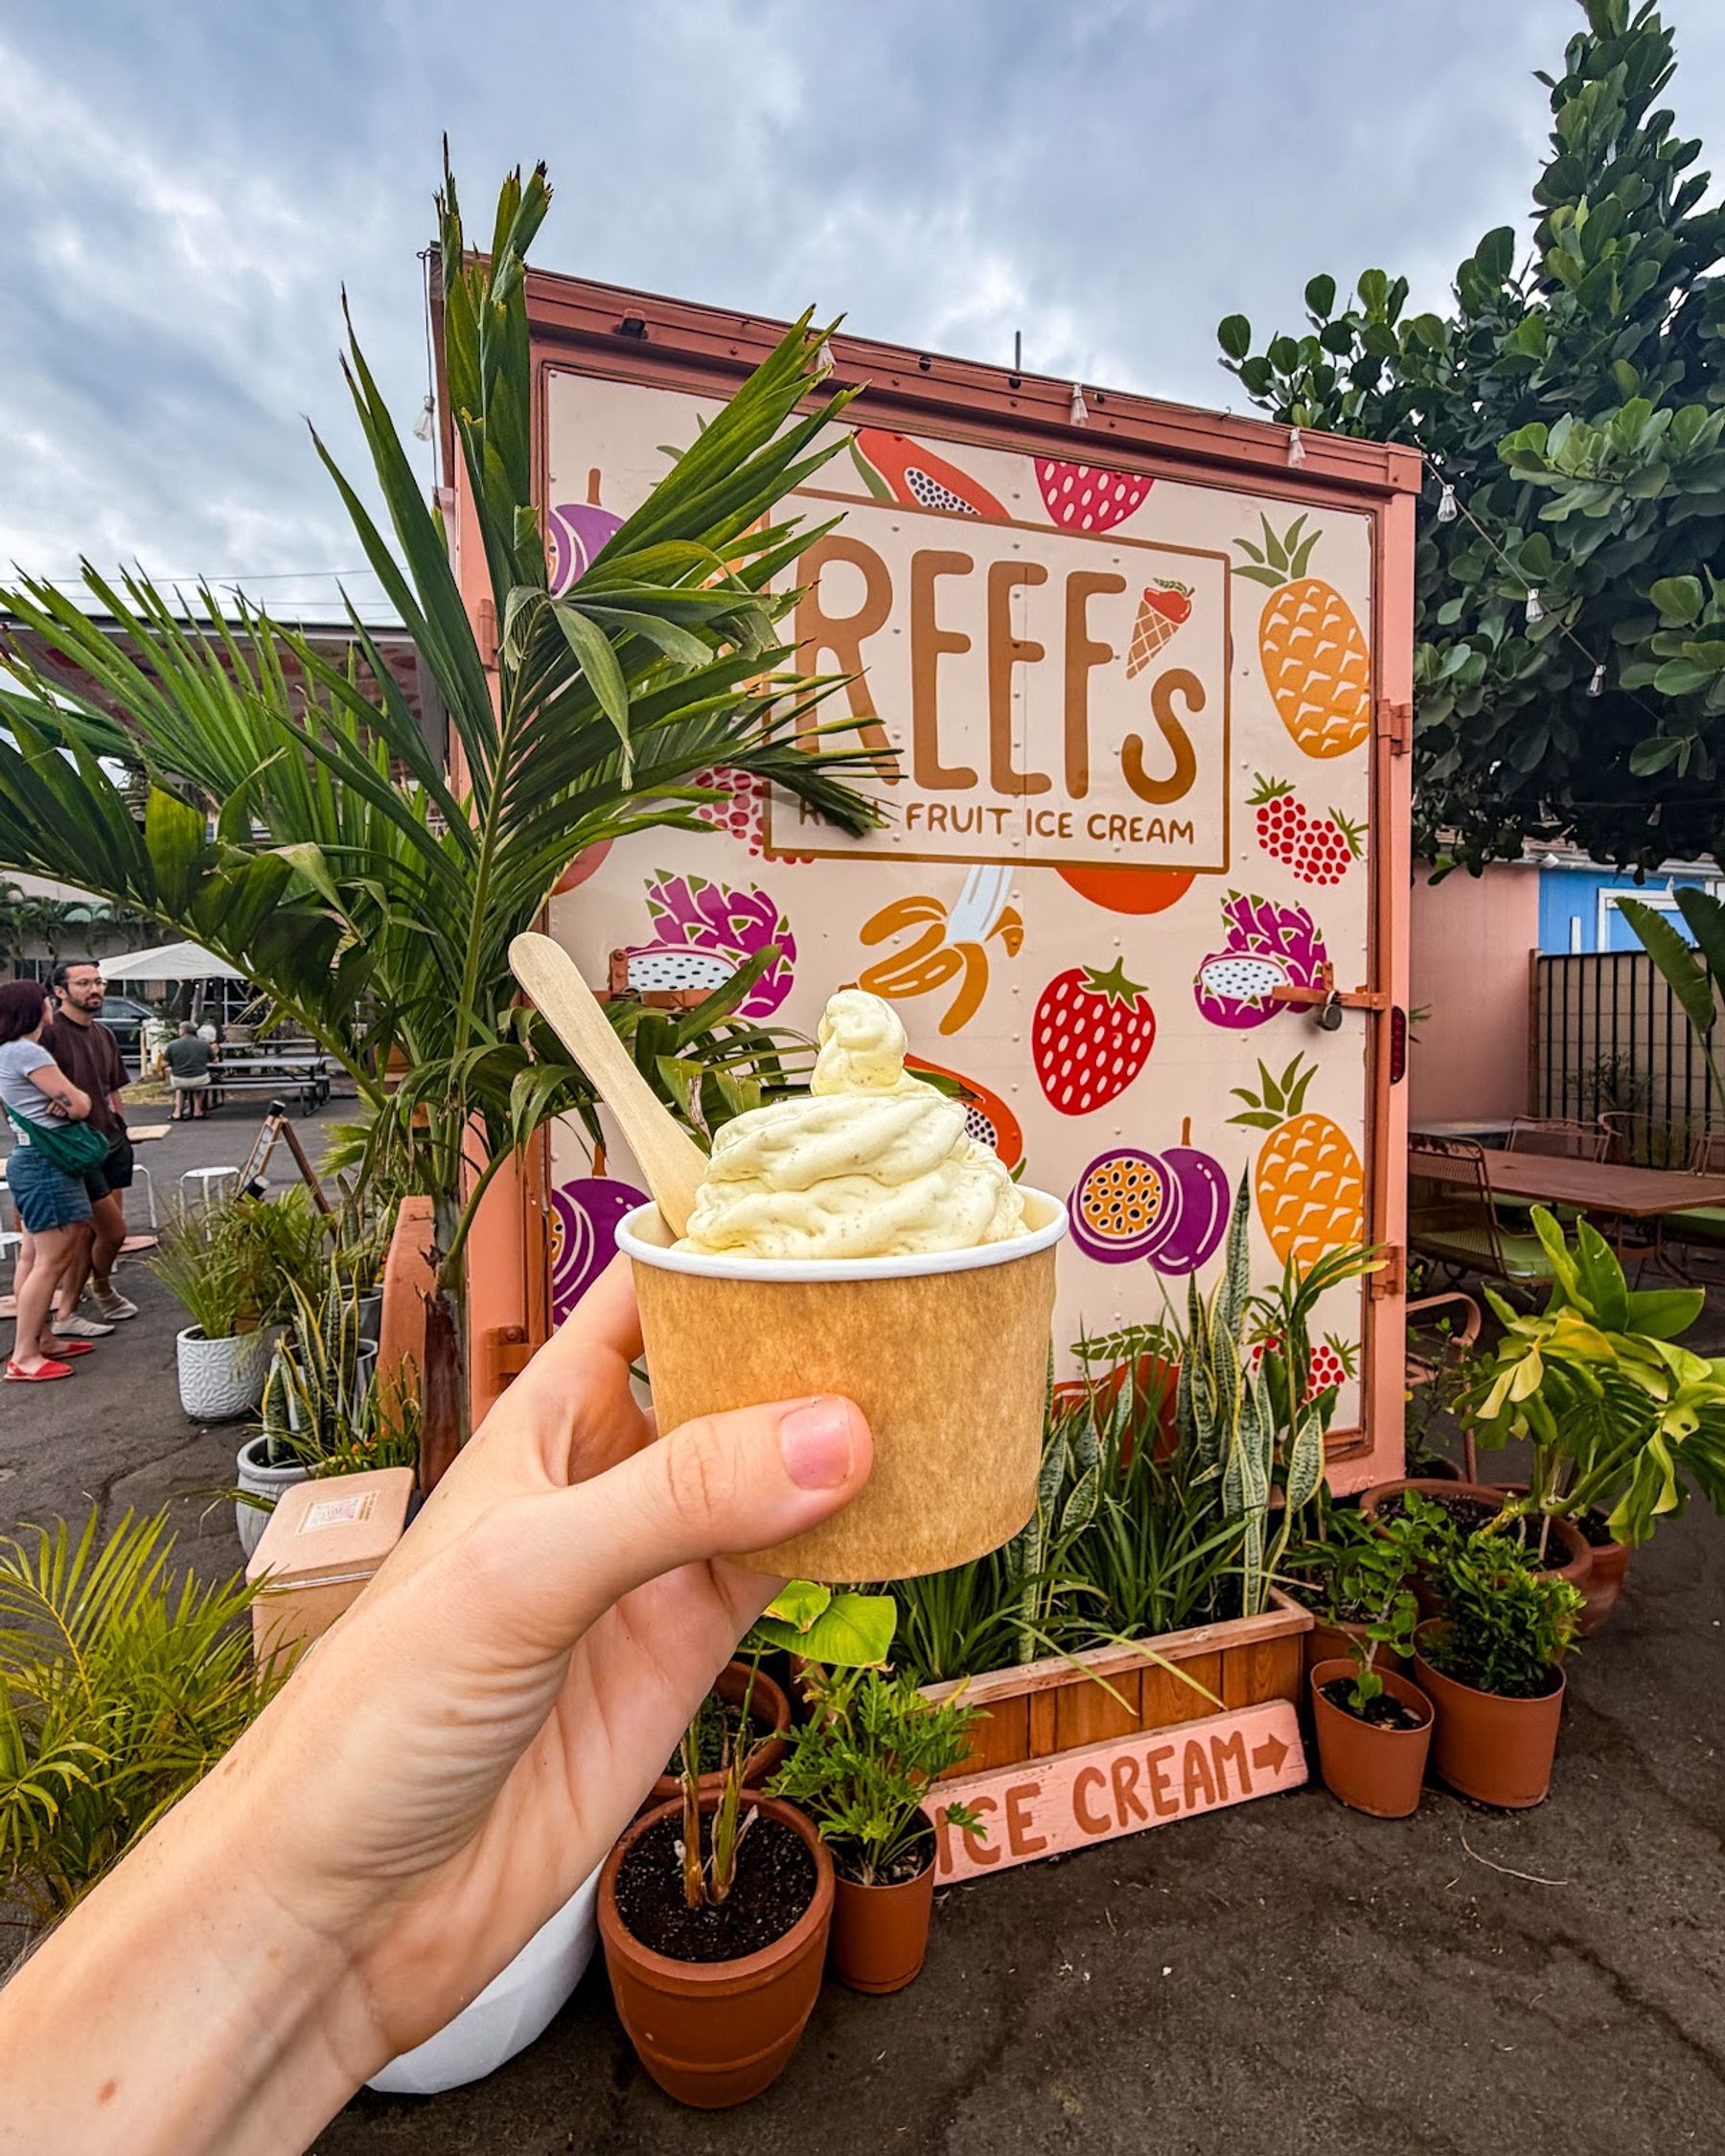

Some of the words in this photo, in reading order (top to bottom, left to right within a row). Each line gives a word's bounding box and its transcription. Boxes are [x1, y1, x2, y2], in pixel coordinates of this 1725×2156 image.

[906, 803, 1013, 835] FRUIT
[1026, 808, 1073, 838] ICE
[1087, 814, 1194, 844] CREAM
[935, 1781, 1047, 1875] ICE
[1072, 1731, 1253, 1835] CREAM
